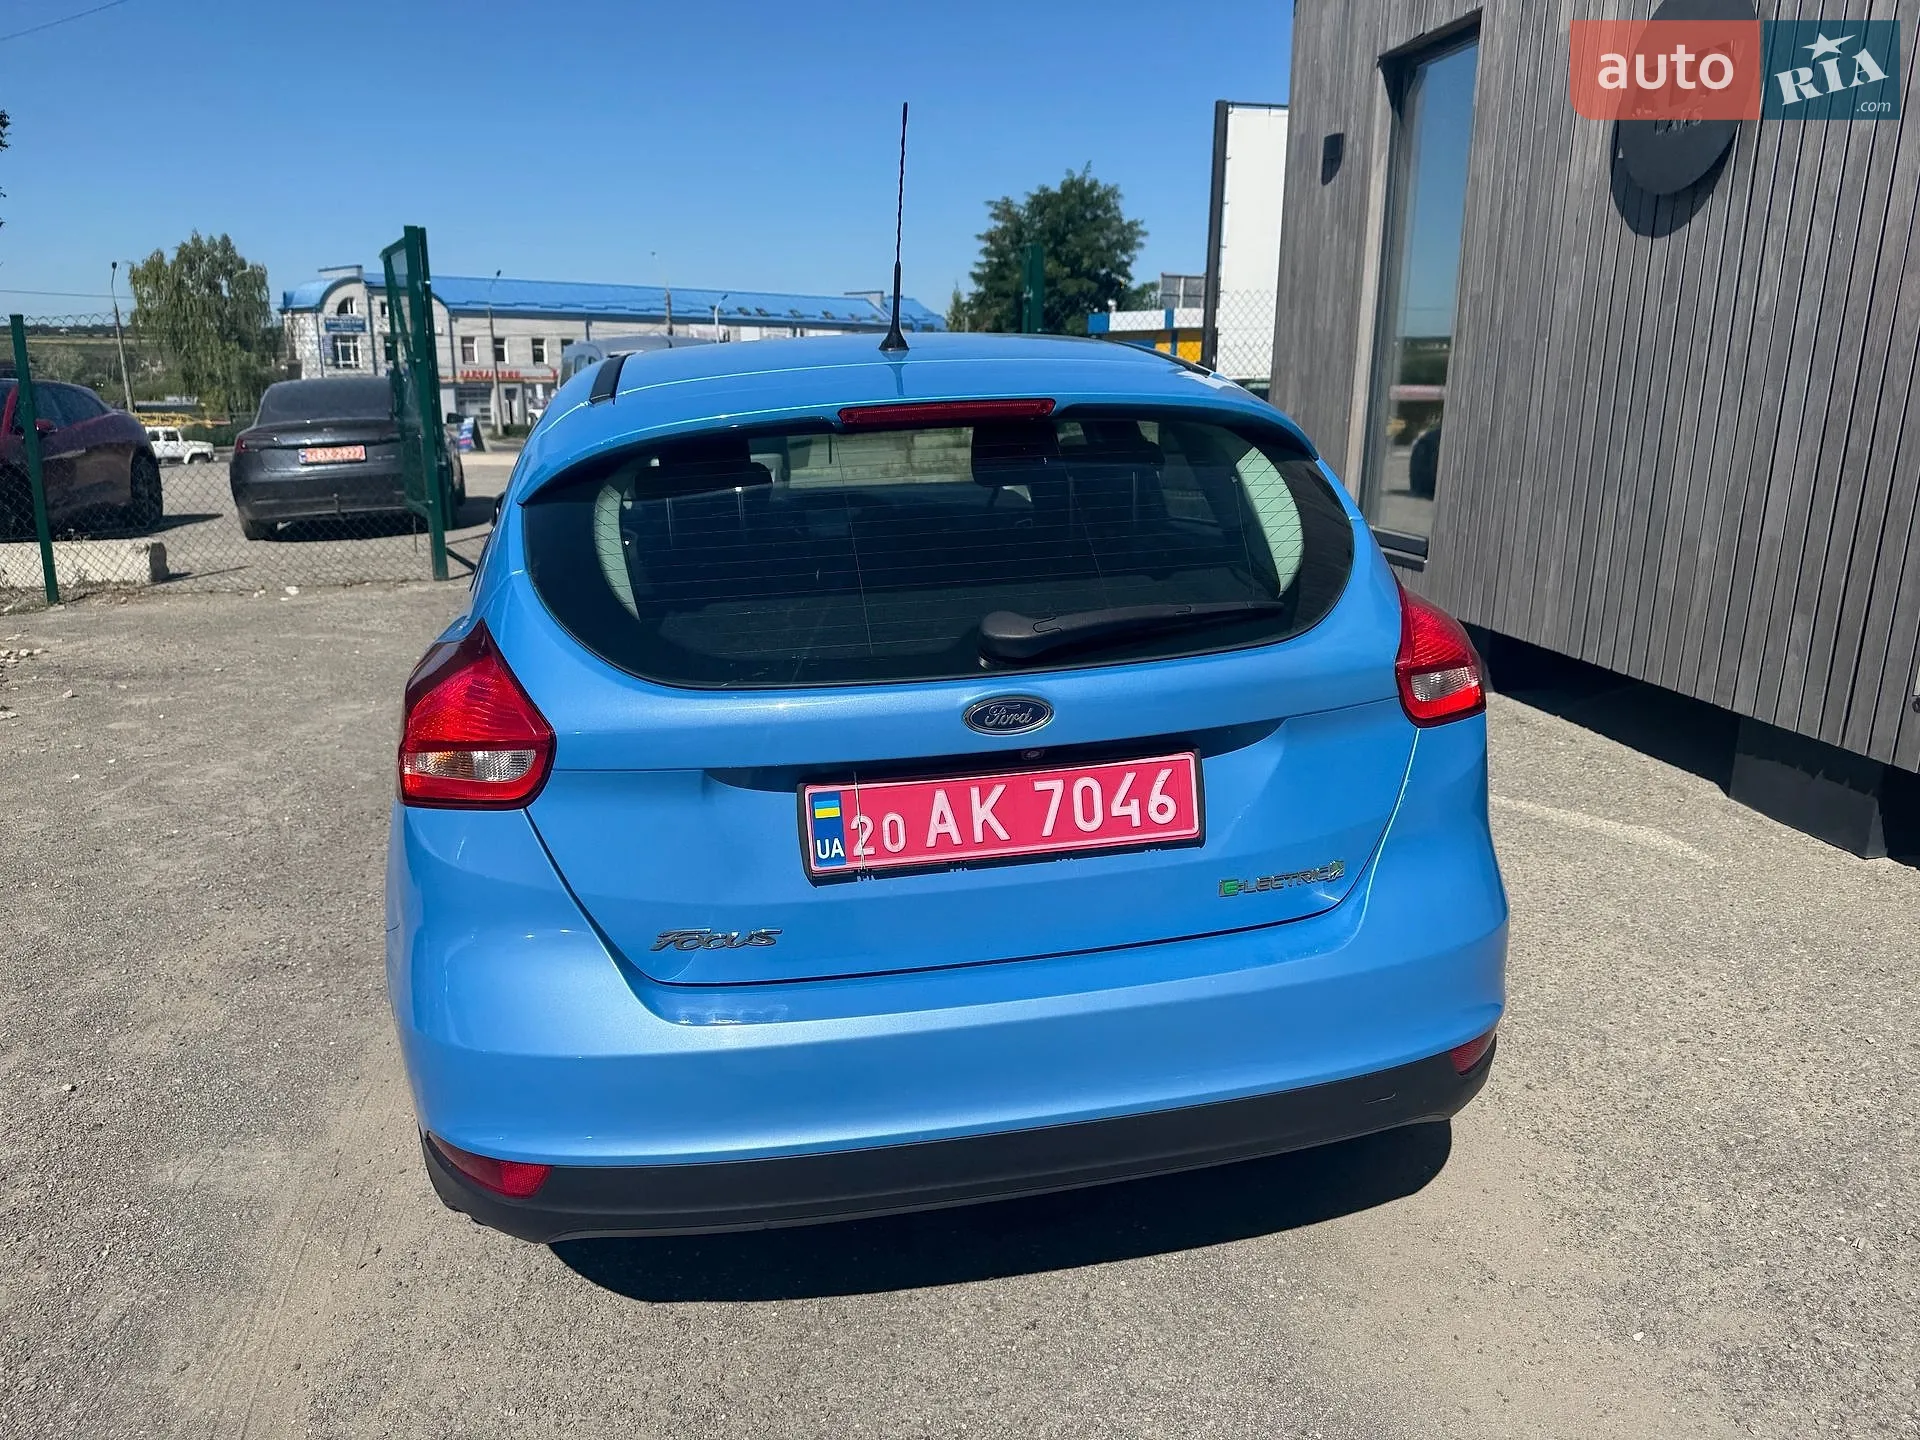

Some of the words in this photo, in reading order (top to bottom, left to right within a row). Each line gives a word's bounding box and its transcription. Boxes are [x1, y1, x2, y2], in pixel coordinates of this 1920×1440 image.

[984, 703, 1033, 727] Ford
[816, 838, 846, 861] UA
[850, 811, 907, 858] 20
[924, 784, 1011, 849] AK
[1033, 768, 1178, 838] 7046
